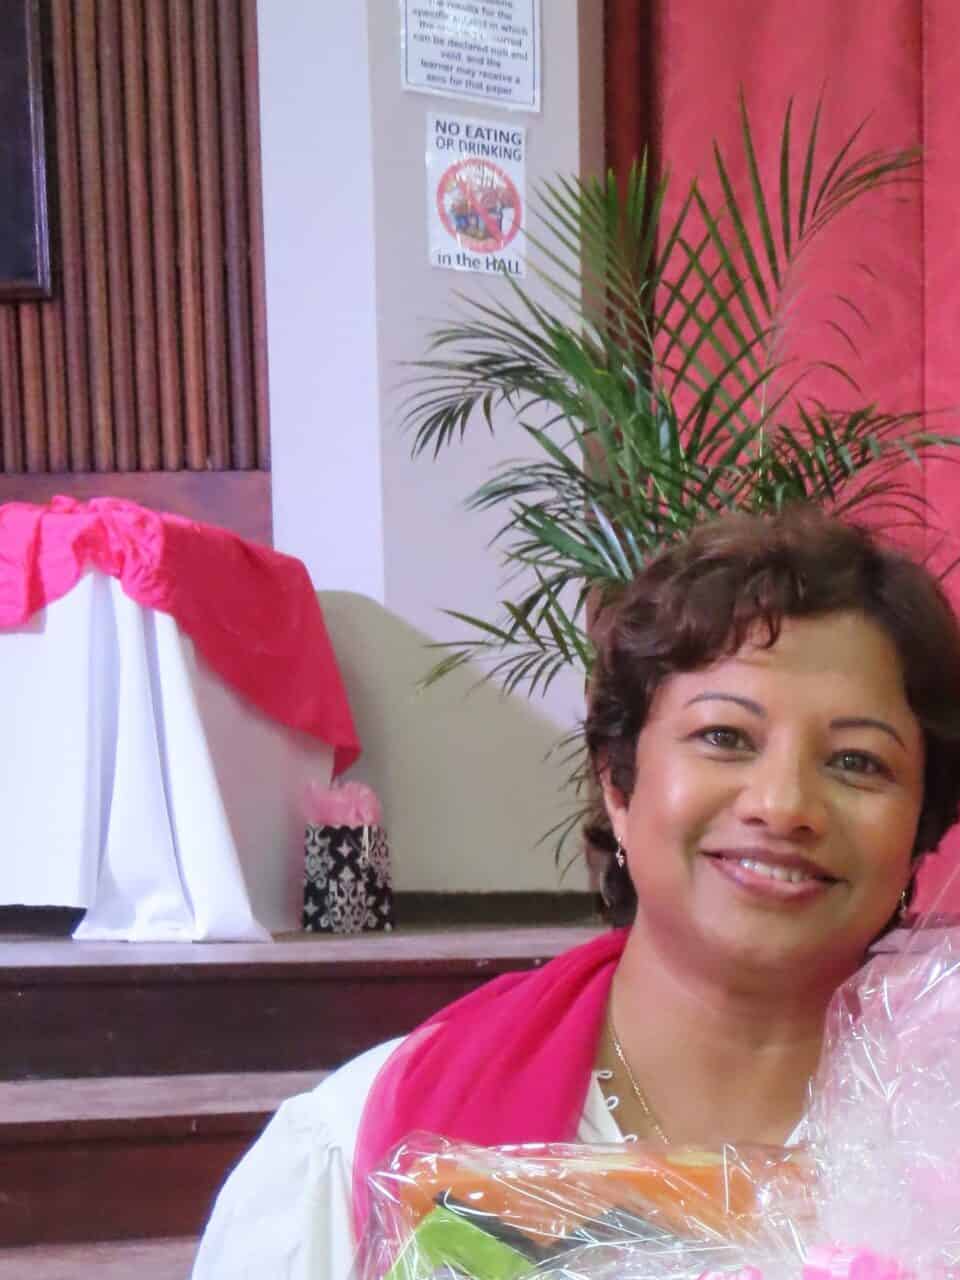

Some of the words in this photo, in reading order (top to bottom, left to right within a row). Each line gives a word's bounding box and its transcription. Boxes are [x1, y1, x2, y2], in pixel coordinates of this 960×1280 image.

[447, 38, 488, 53] declared
[420, 58, 453, 71] learner
[456, 64, 476, 79] may
[479, 70, 513, 83] receive
[466, 54, 484, 65] and
[465, 78, 483, 90] that
[435, 119, 460, 137] NO
[465, 125, 522, 146] EATING
[435, 135, 454, 150] OR
[457, 140, 522, 162] DRINKING
[437, 252, 451, 266] in
[456, 253, 481, 269] the
[485, 256, 522, 274] HALL
